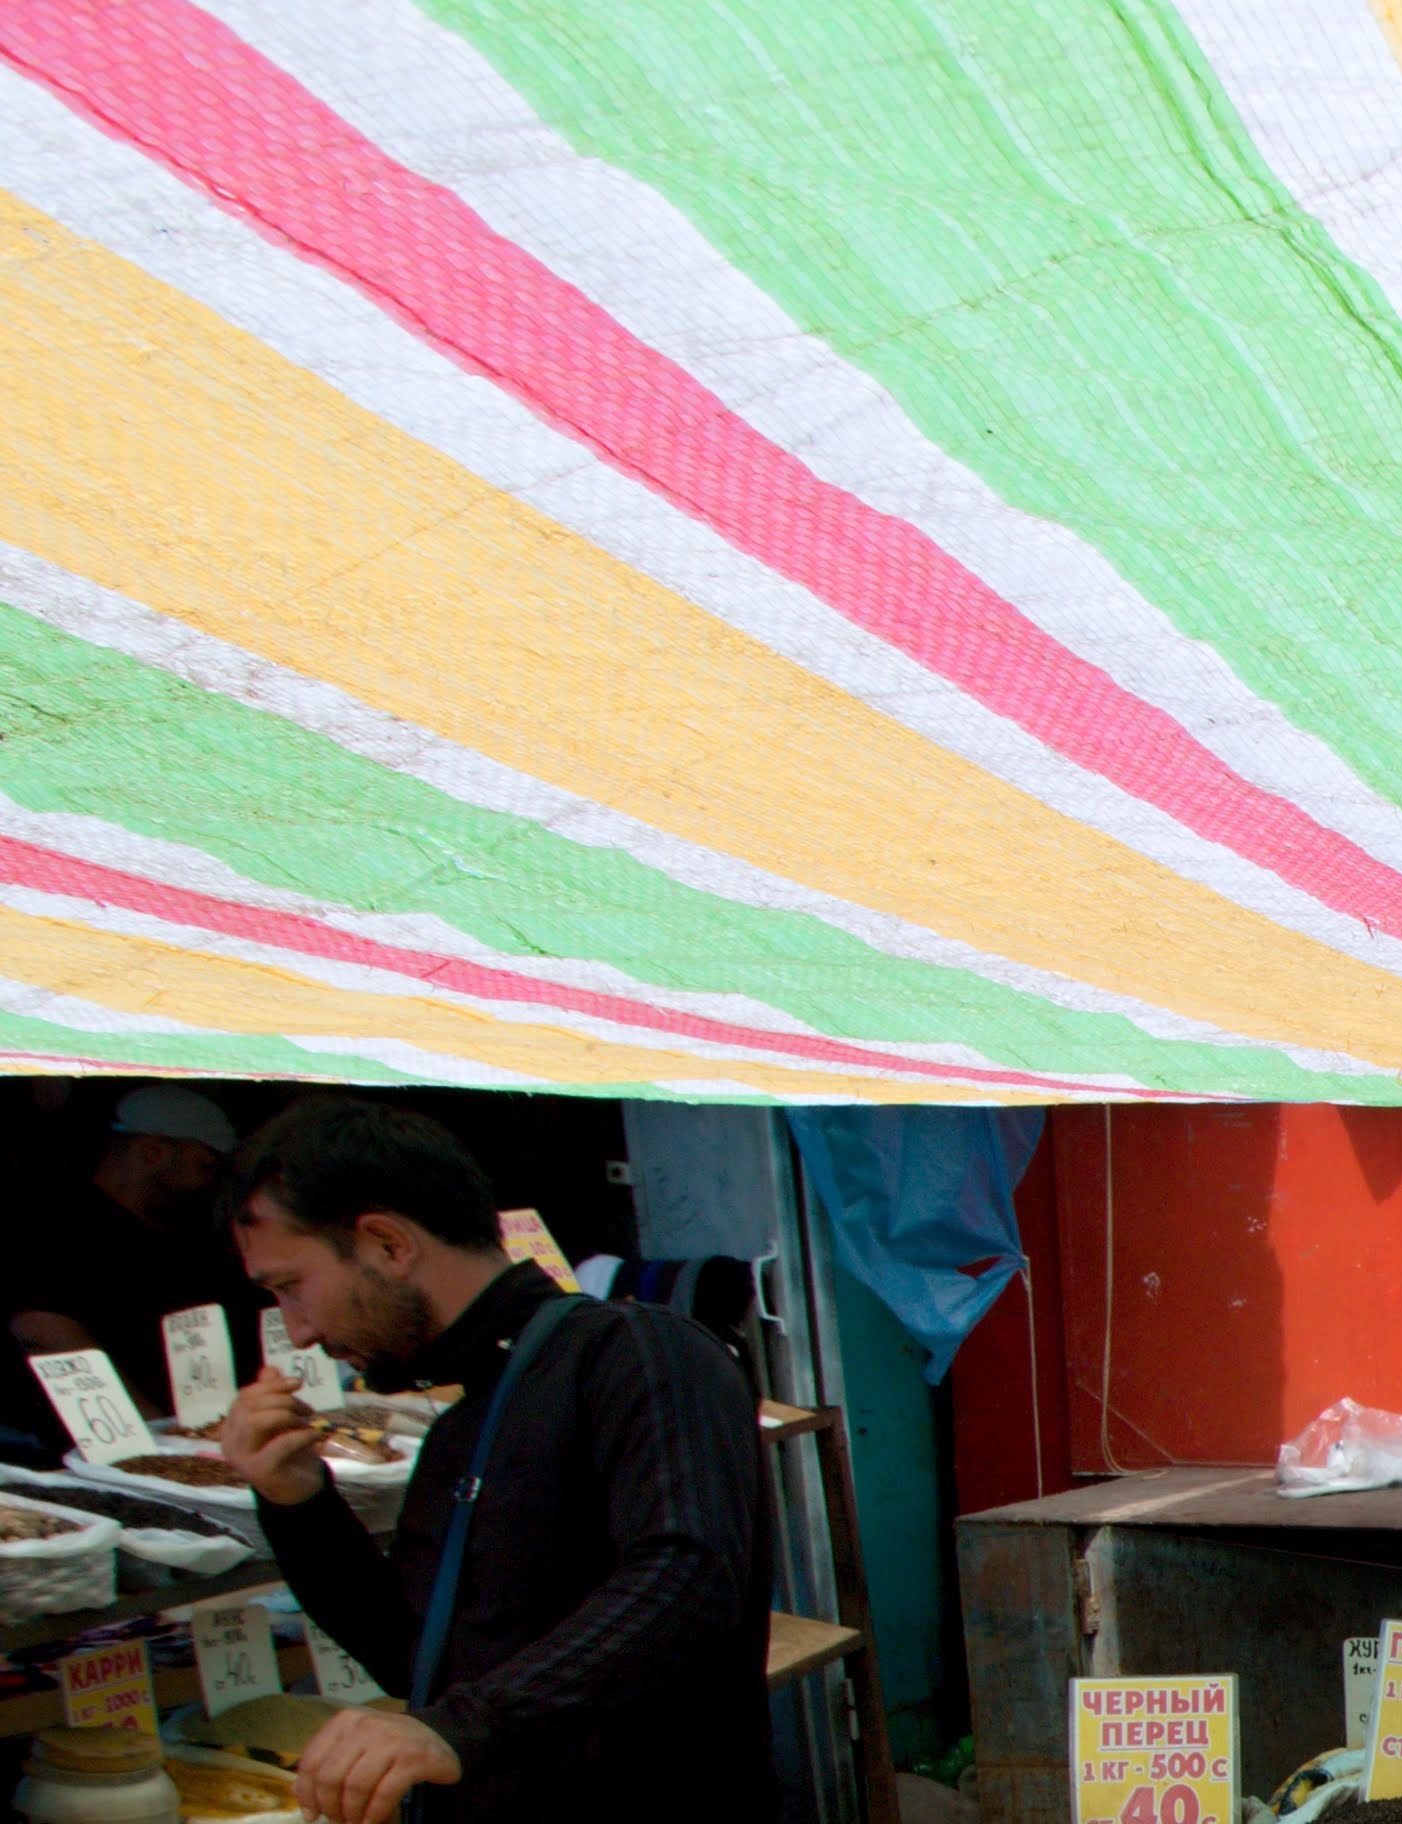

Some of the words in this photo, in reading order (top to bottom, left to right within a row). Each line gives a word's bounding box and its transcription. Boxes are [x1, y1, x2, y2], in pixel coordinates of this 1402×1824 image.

[71, 1649, 140, 1690] КАРРИ
[1083, 1685, 1224, 1715] ЧЕРНЫЙ
[1387, 1682, 1395, 1697] 1
[1103, 1721, 1208, 1746] ПЕРЕЦ
[1084, 1762, 1096, 1779] 1
[1152, 1752, 1205, 1779] 500
